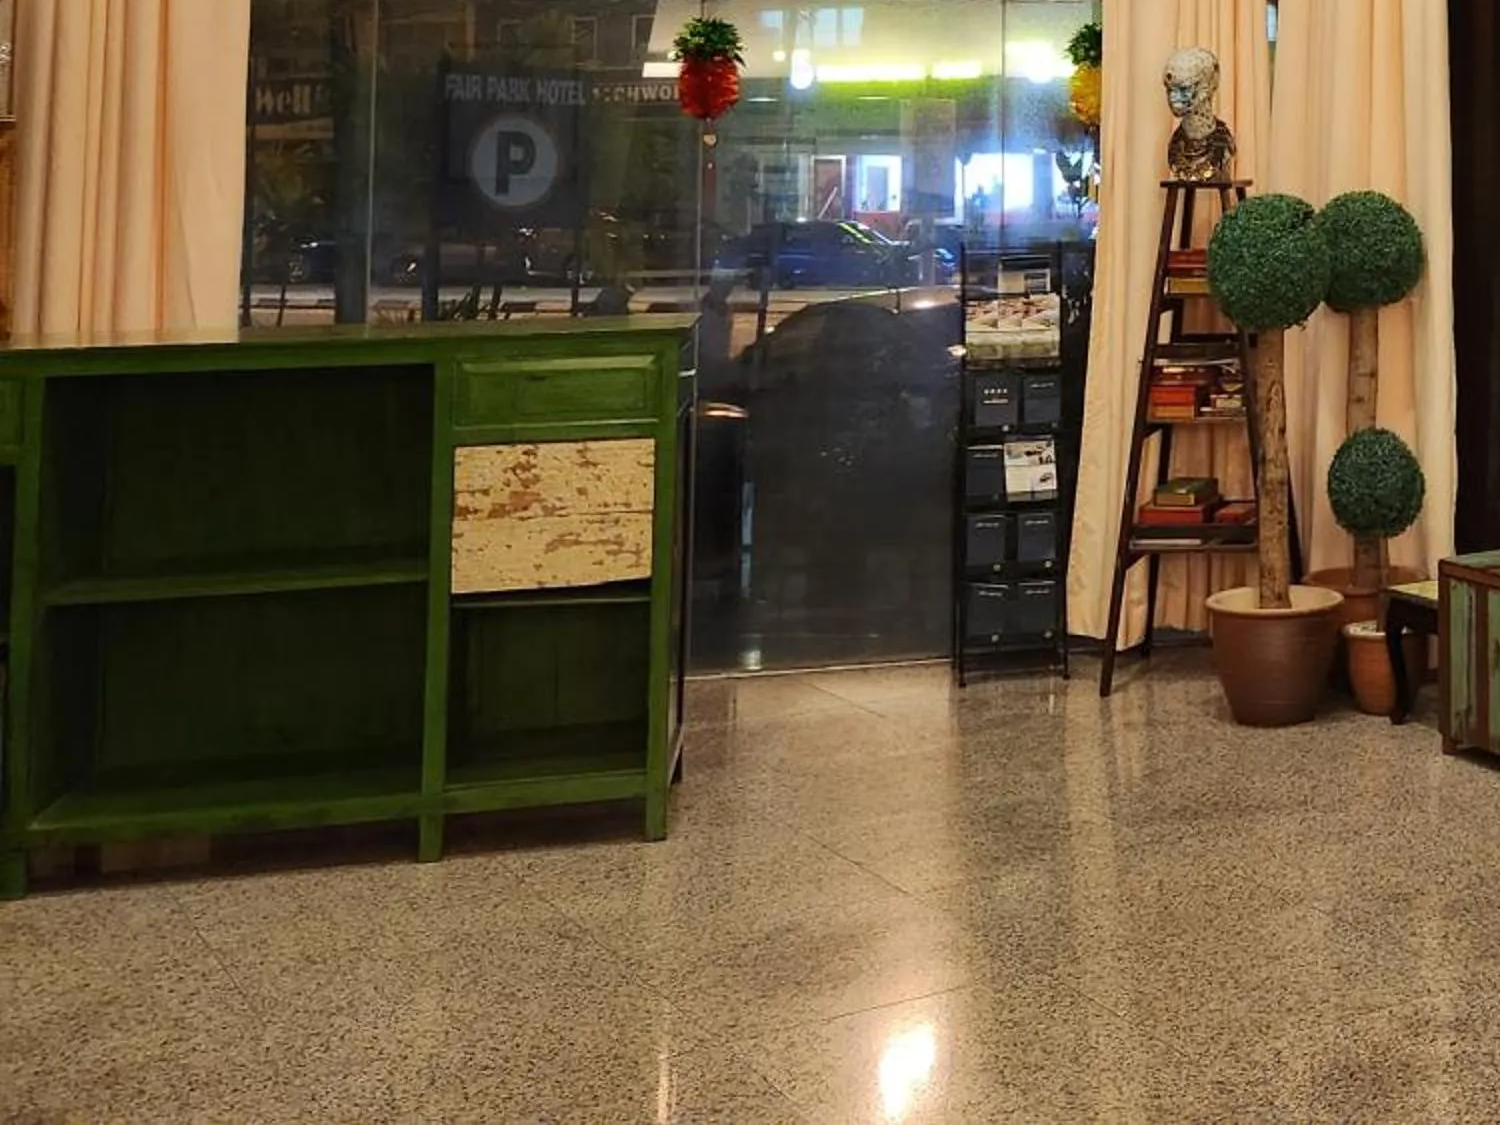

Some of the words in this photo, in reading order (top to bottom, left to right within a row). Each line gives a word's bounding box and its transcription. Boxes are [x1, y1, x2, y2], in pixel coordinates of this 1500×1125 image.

[444, 74, 482, 102] FAIR
[485, 76, 532, 104] PARK
[535, 78, 587, 106] HOTEL
[495, 130, 537, 196] P
